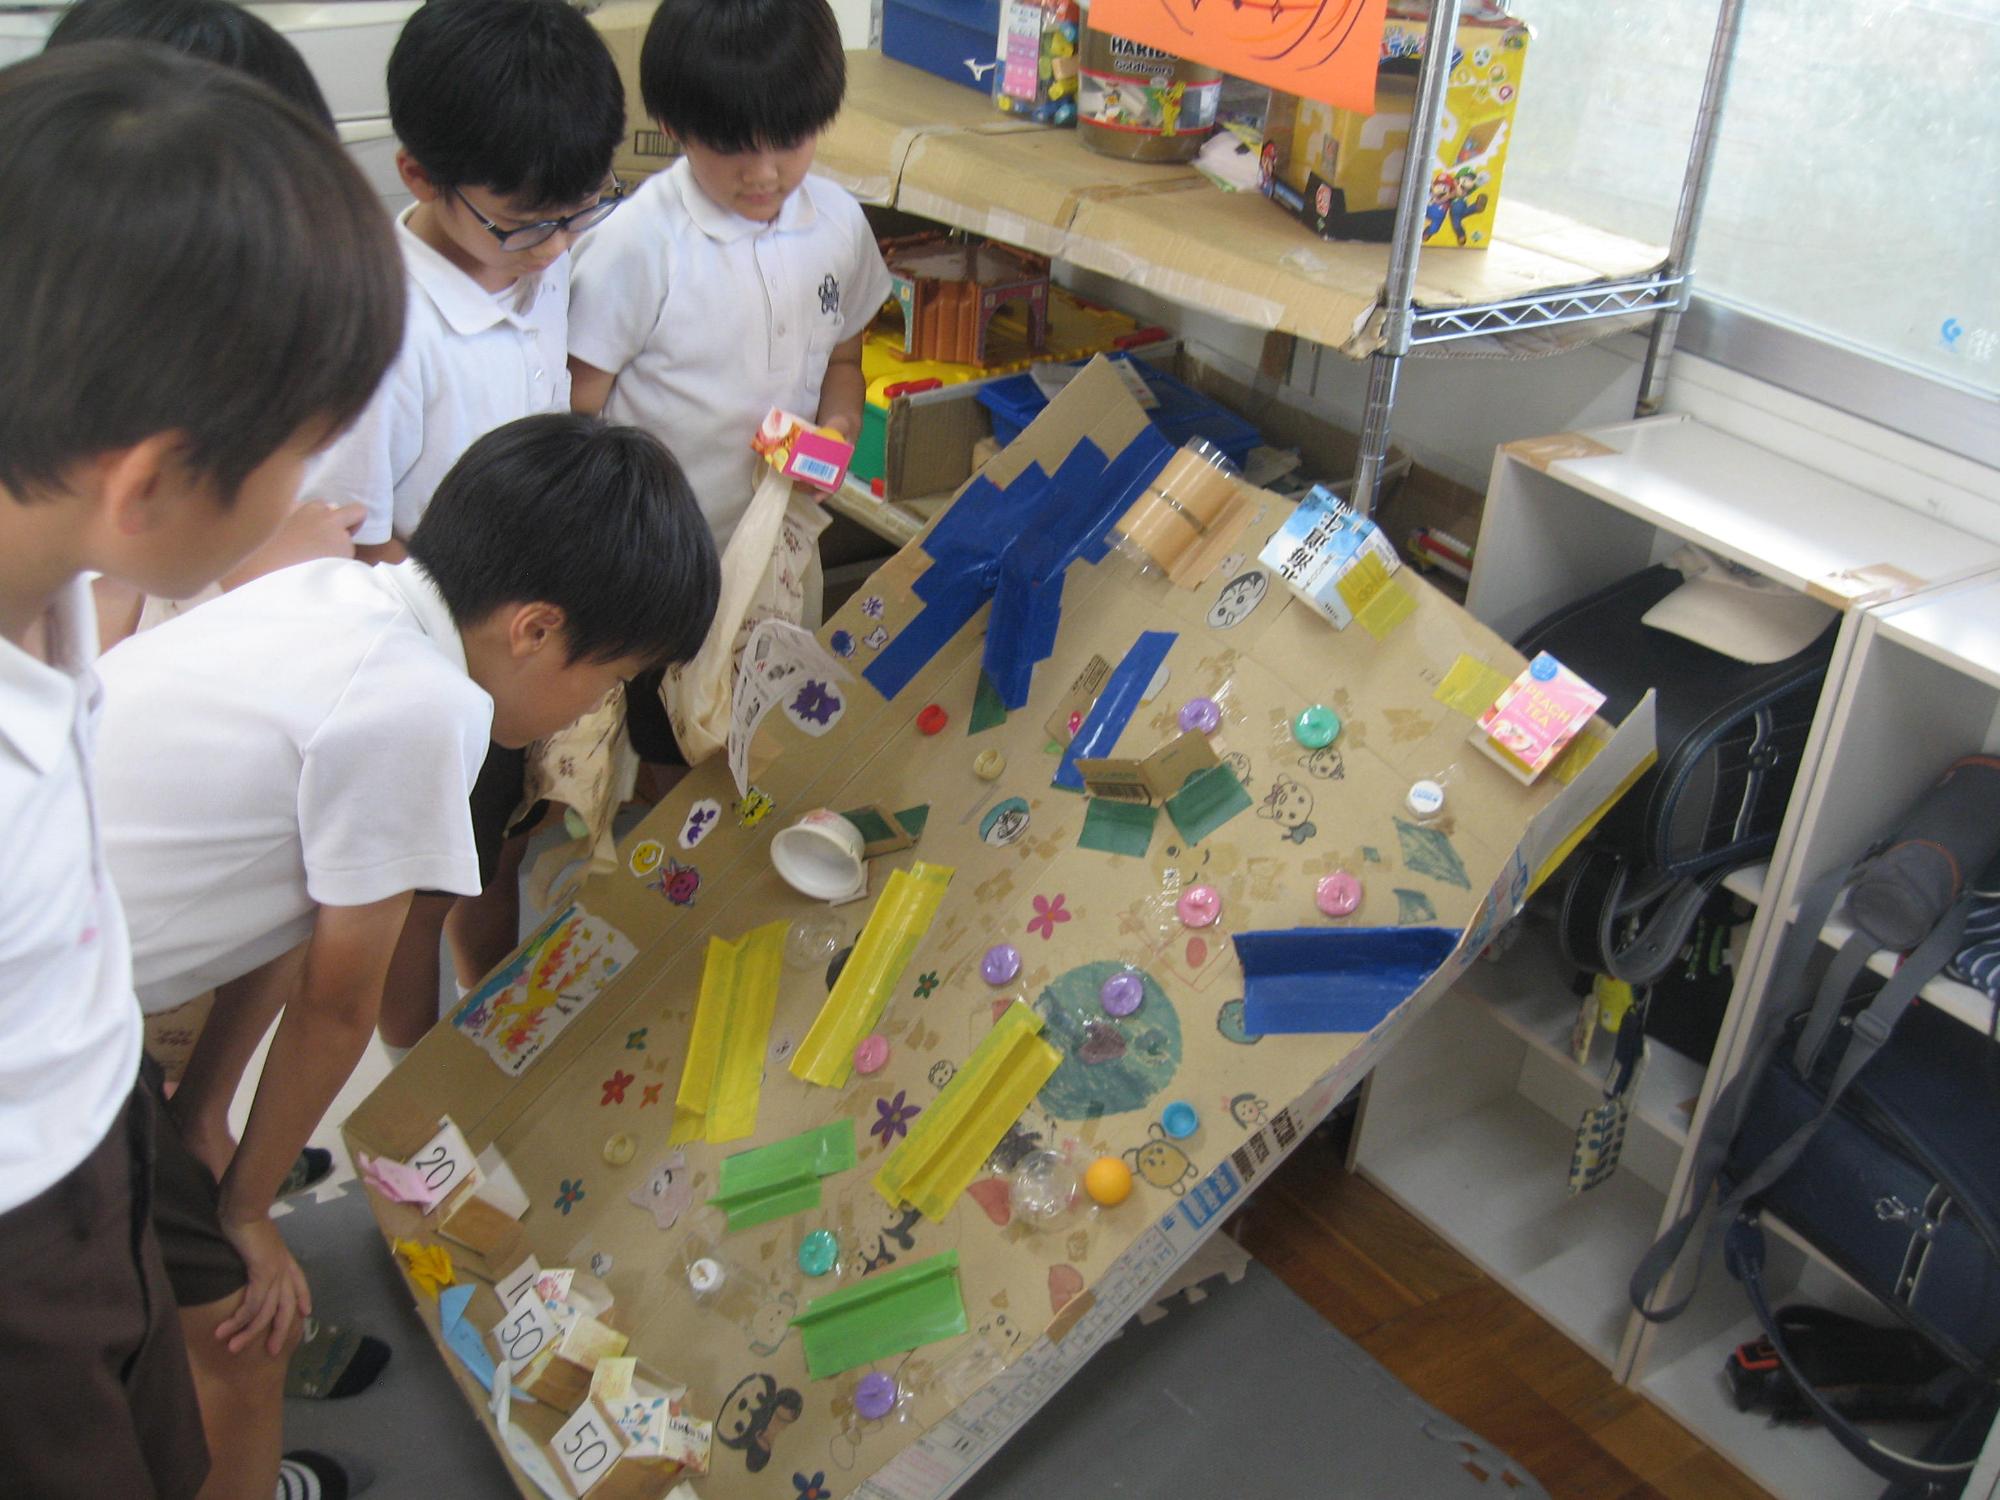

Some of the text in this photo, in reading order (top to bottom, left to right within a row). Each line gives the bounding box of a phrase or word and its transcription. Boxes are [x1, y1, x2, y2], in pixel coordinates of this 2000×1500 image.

[1524, 683, 1571, 724] PEACH
[1527, 701, 1550, 728] TEA
[415, 1146, 455, 1191] 20
[501, 1308, 543, 1360] 50
[564, 1420, 607, 1473] 50
